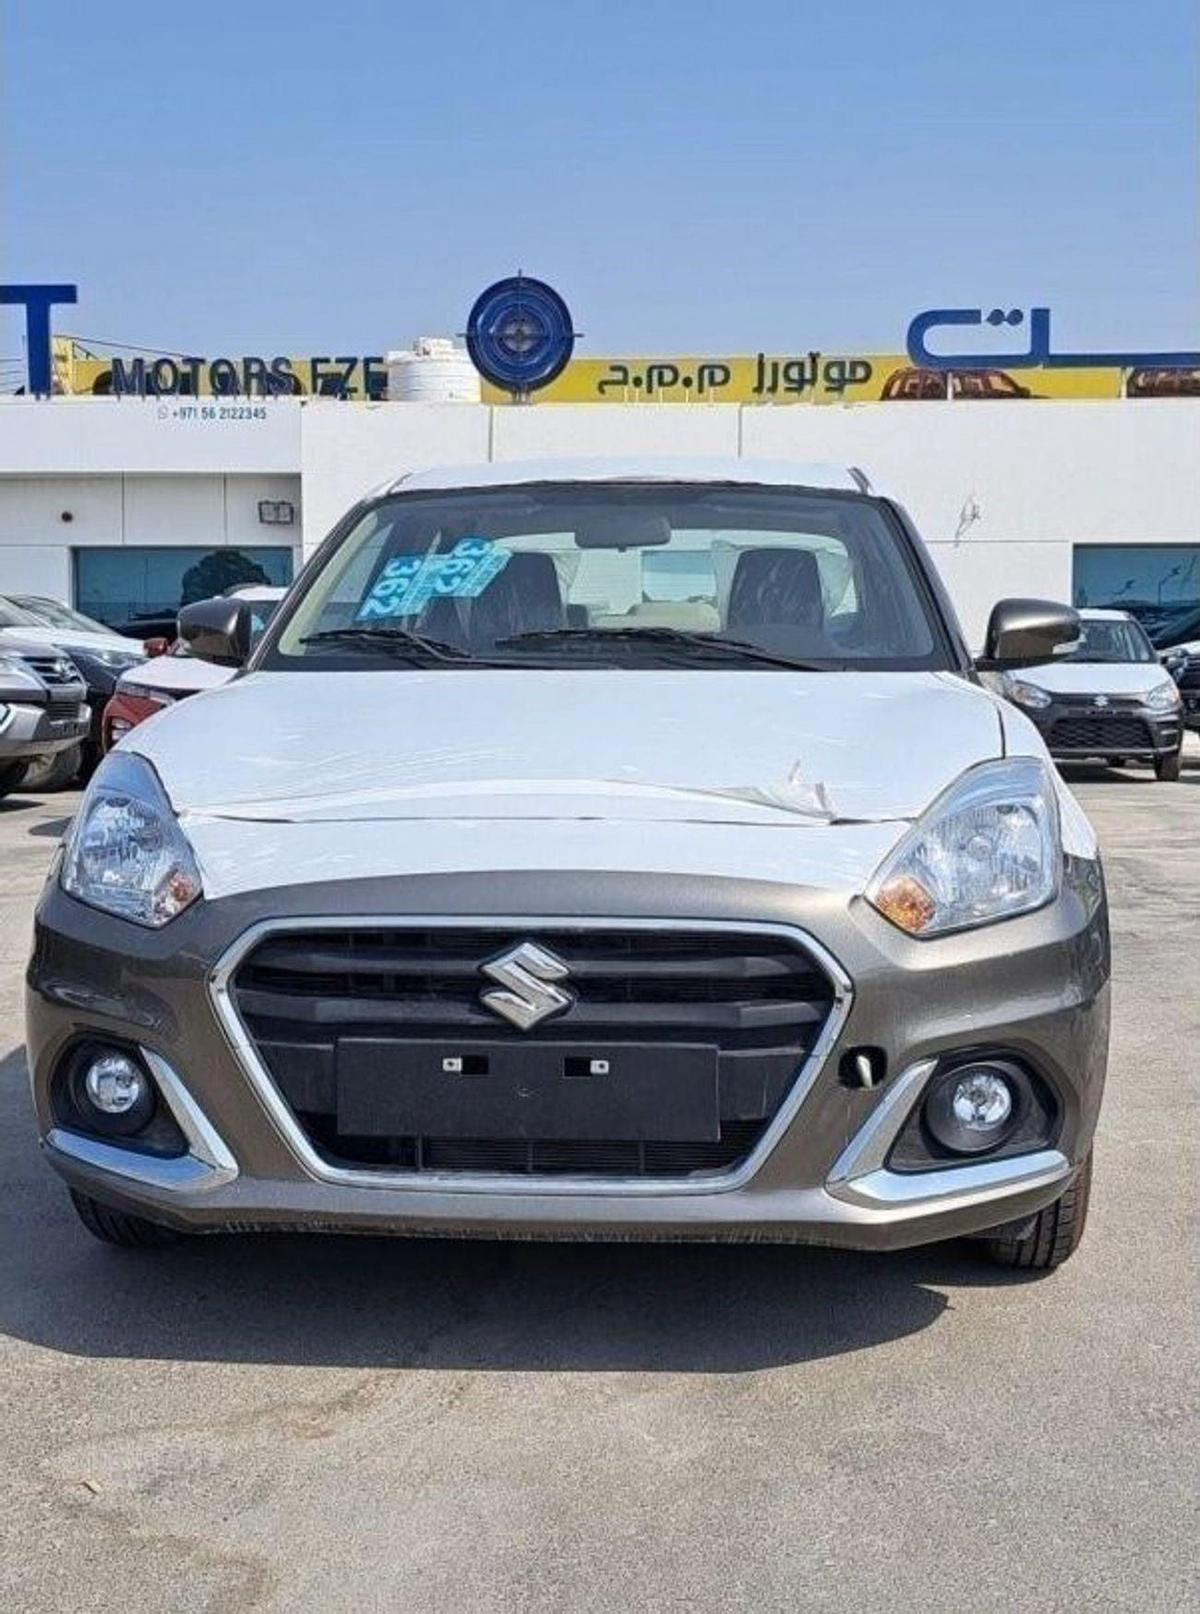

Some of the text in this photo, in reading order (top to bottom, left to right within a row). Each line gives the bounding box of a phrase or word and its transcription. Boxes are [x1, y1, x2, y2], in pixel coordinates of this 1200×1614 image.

[111, 357, 293, 394] MOTORS
[201, 406, 217, 420] 56
[219, 406, 266, 420] 2122345
[359, 558, 422, 617] 362
